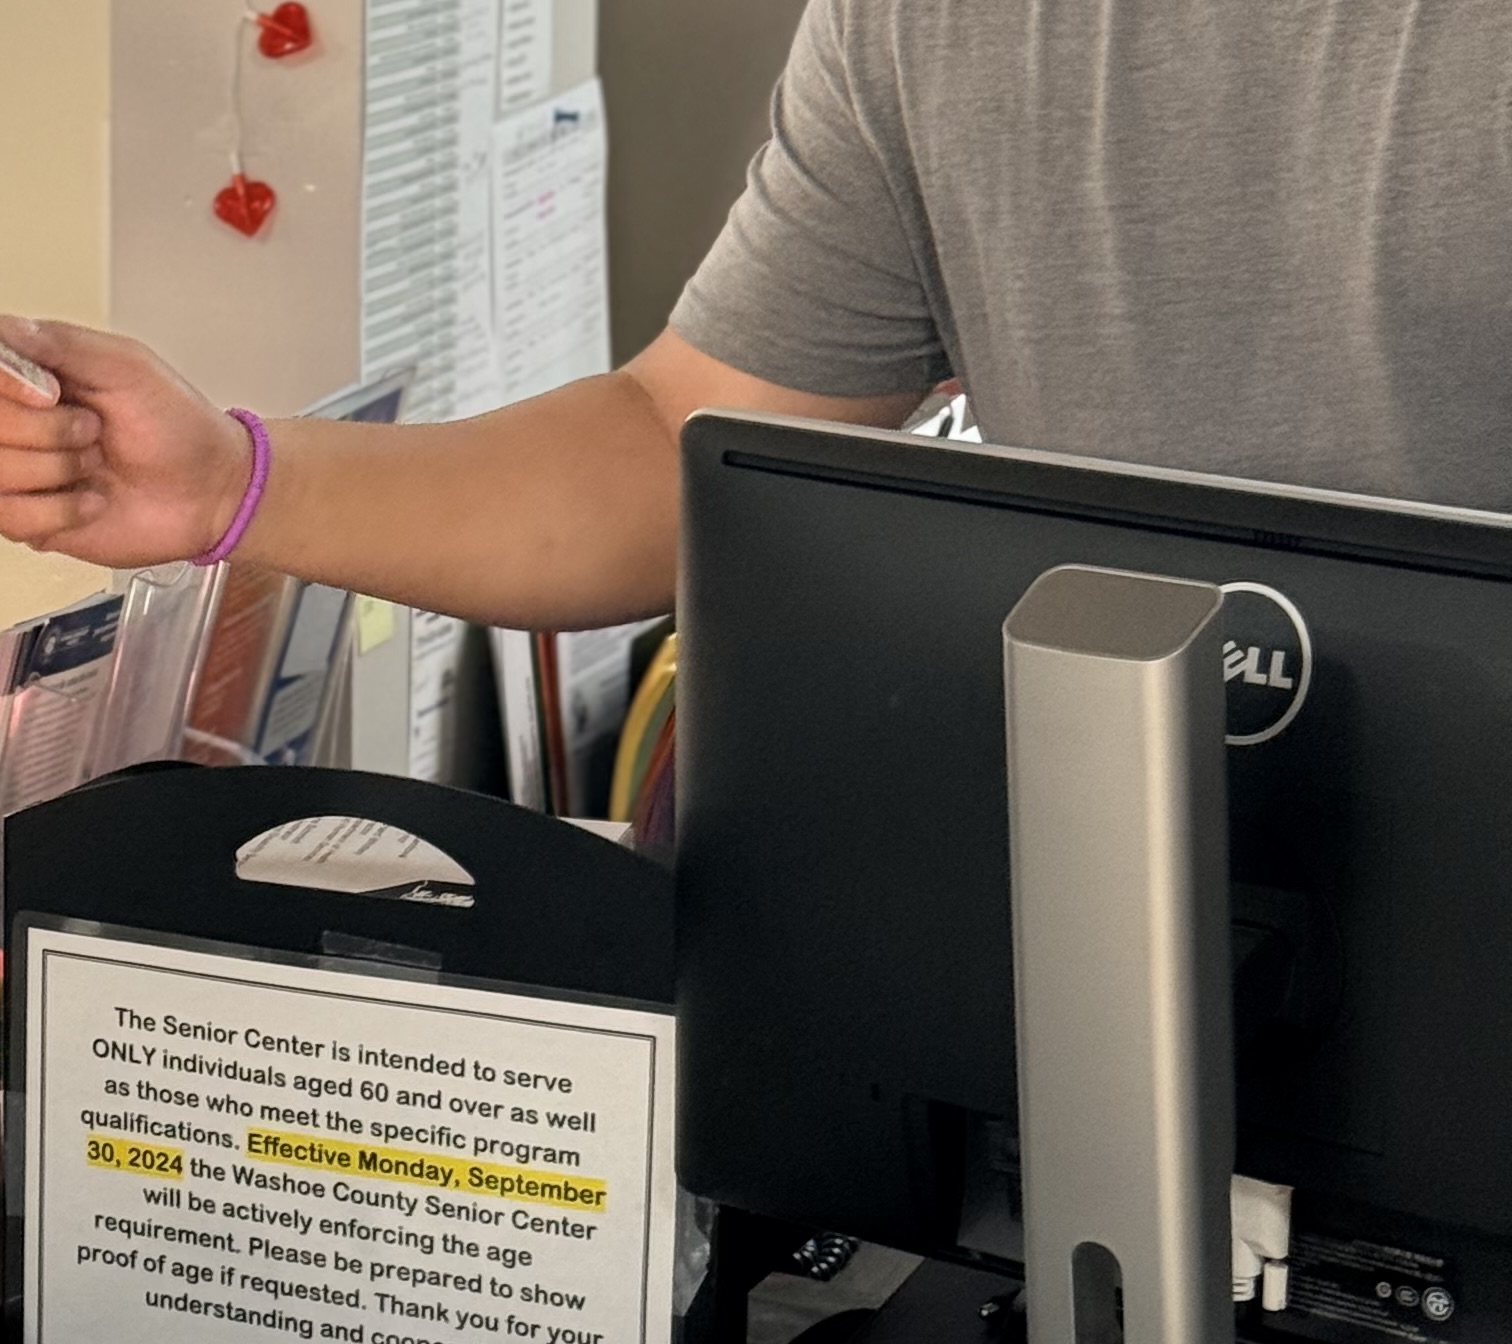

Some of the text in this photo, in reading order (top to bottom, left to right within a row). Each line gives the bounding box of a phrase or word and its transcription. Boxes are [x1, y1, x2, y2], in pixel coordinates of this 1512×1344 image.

[1222, 640, 1294, 690] ELL
[92, 1038, 596, 1133] ONLY individuals aged 60 and over as well
[114, 1006, 573, 1094] The Senior Center is intended to serve
[80, 1109, 607, 1206] qualifications. Effective Monday, September
[104, 1079, 580, 1167] as those who meet the specific program
[87, 1140, 598, 1240] 30, 2024 the Washoe County Senior Center
[142, 1186, 533, 1270] will be actively enforcing the age
[77, 1245, 139, 1270] proof
[142, 1254, 167, 1275] of
[170, 1261, 214, 1285] age
[220, 1264, 236, 1287] if
[240, 1274, 366, 1310] requested.
[374, 1292, 450, 1324] Thank
[455, 1310, 499, 1332] you
[506, 1314, 542, 1339] for
[94, 1214, 586, 1311] requirement. Please be prepared to show
[145, 1291, 314, 1340] understanding
[320, 1322, 364, 1344] and
